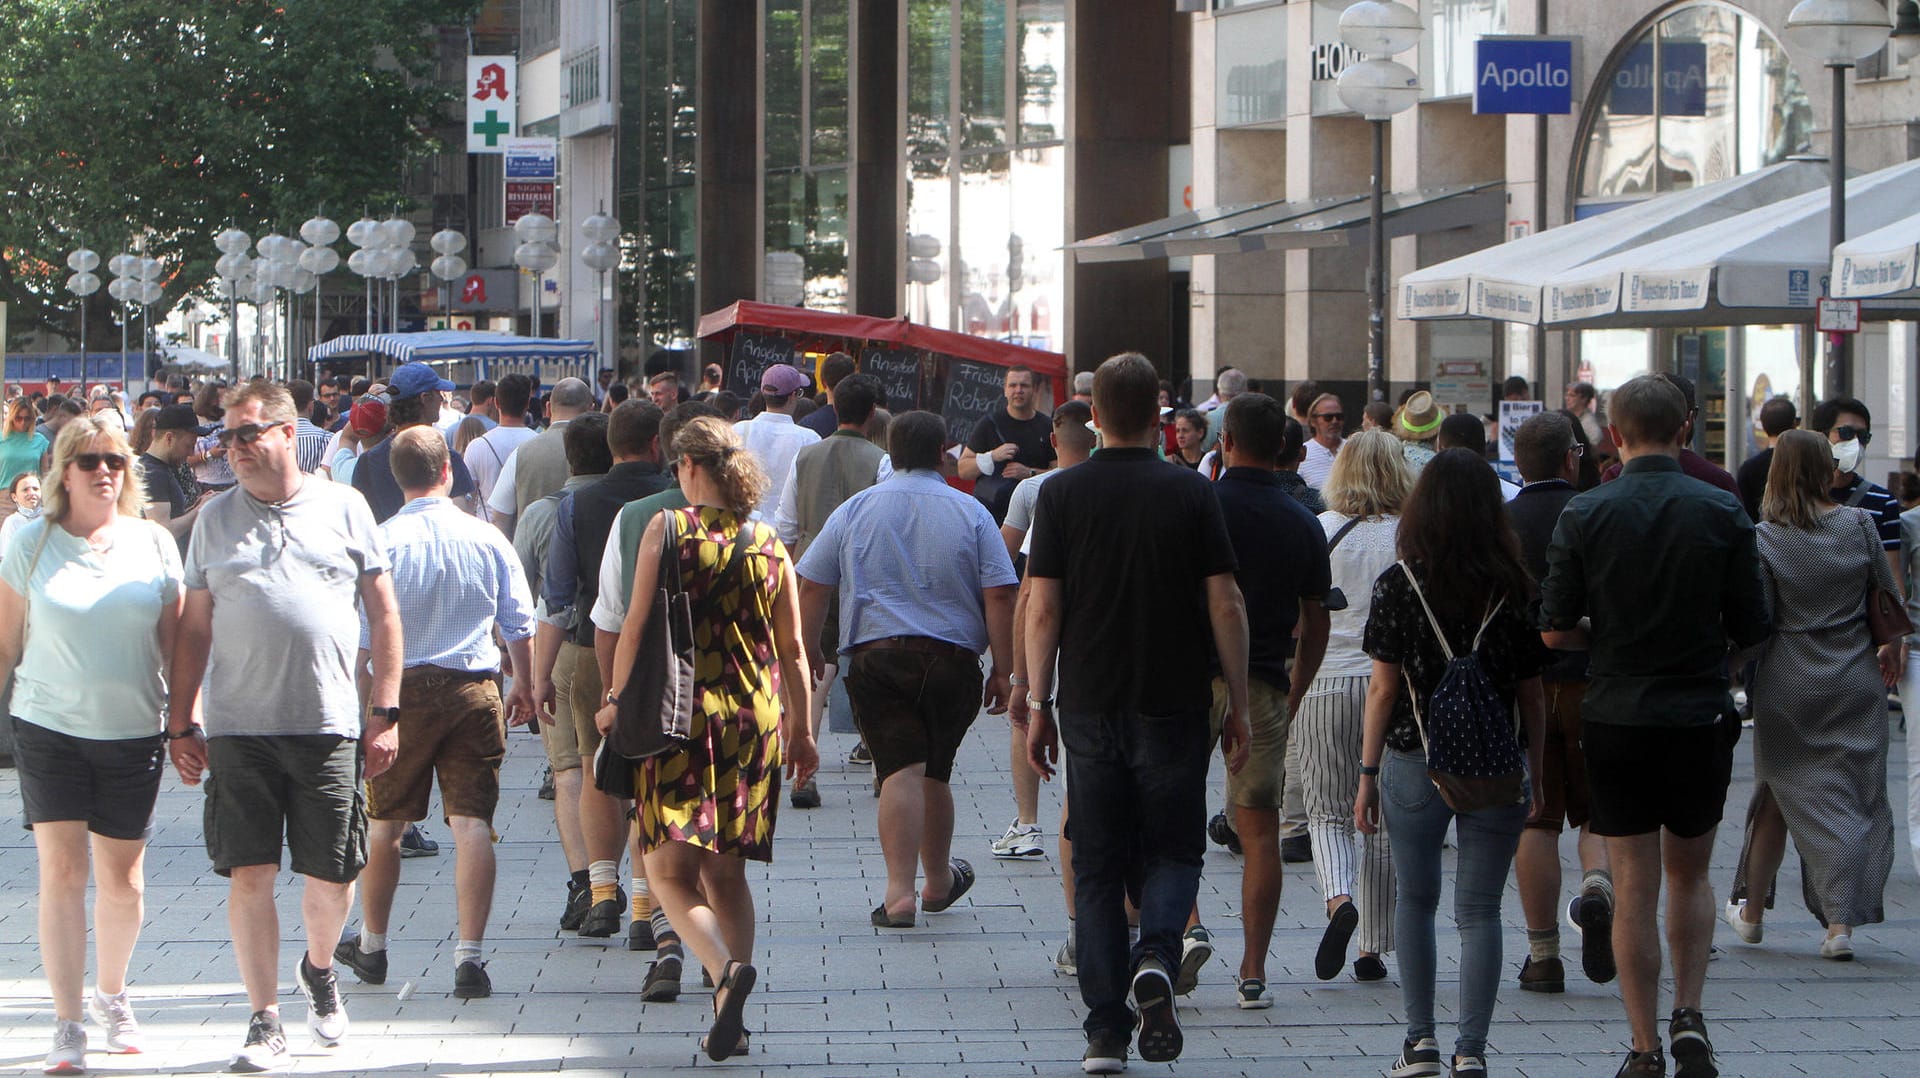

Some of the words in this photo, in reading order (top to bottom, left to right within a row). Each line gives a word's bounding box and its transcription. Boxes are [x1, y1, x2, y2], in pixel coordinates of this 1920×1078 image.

[1310, 41, 1368, 80] HOM
[1480, 61, 1569, 92] Apollo
[742, 338, 791, 365] Angebot
[735, 359, 766, 385] Apri
[870, 352, 919, 380] Angebot
[1512, 403, 1531, 411] Bier
